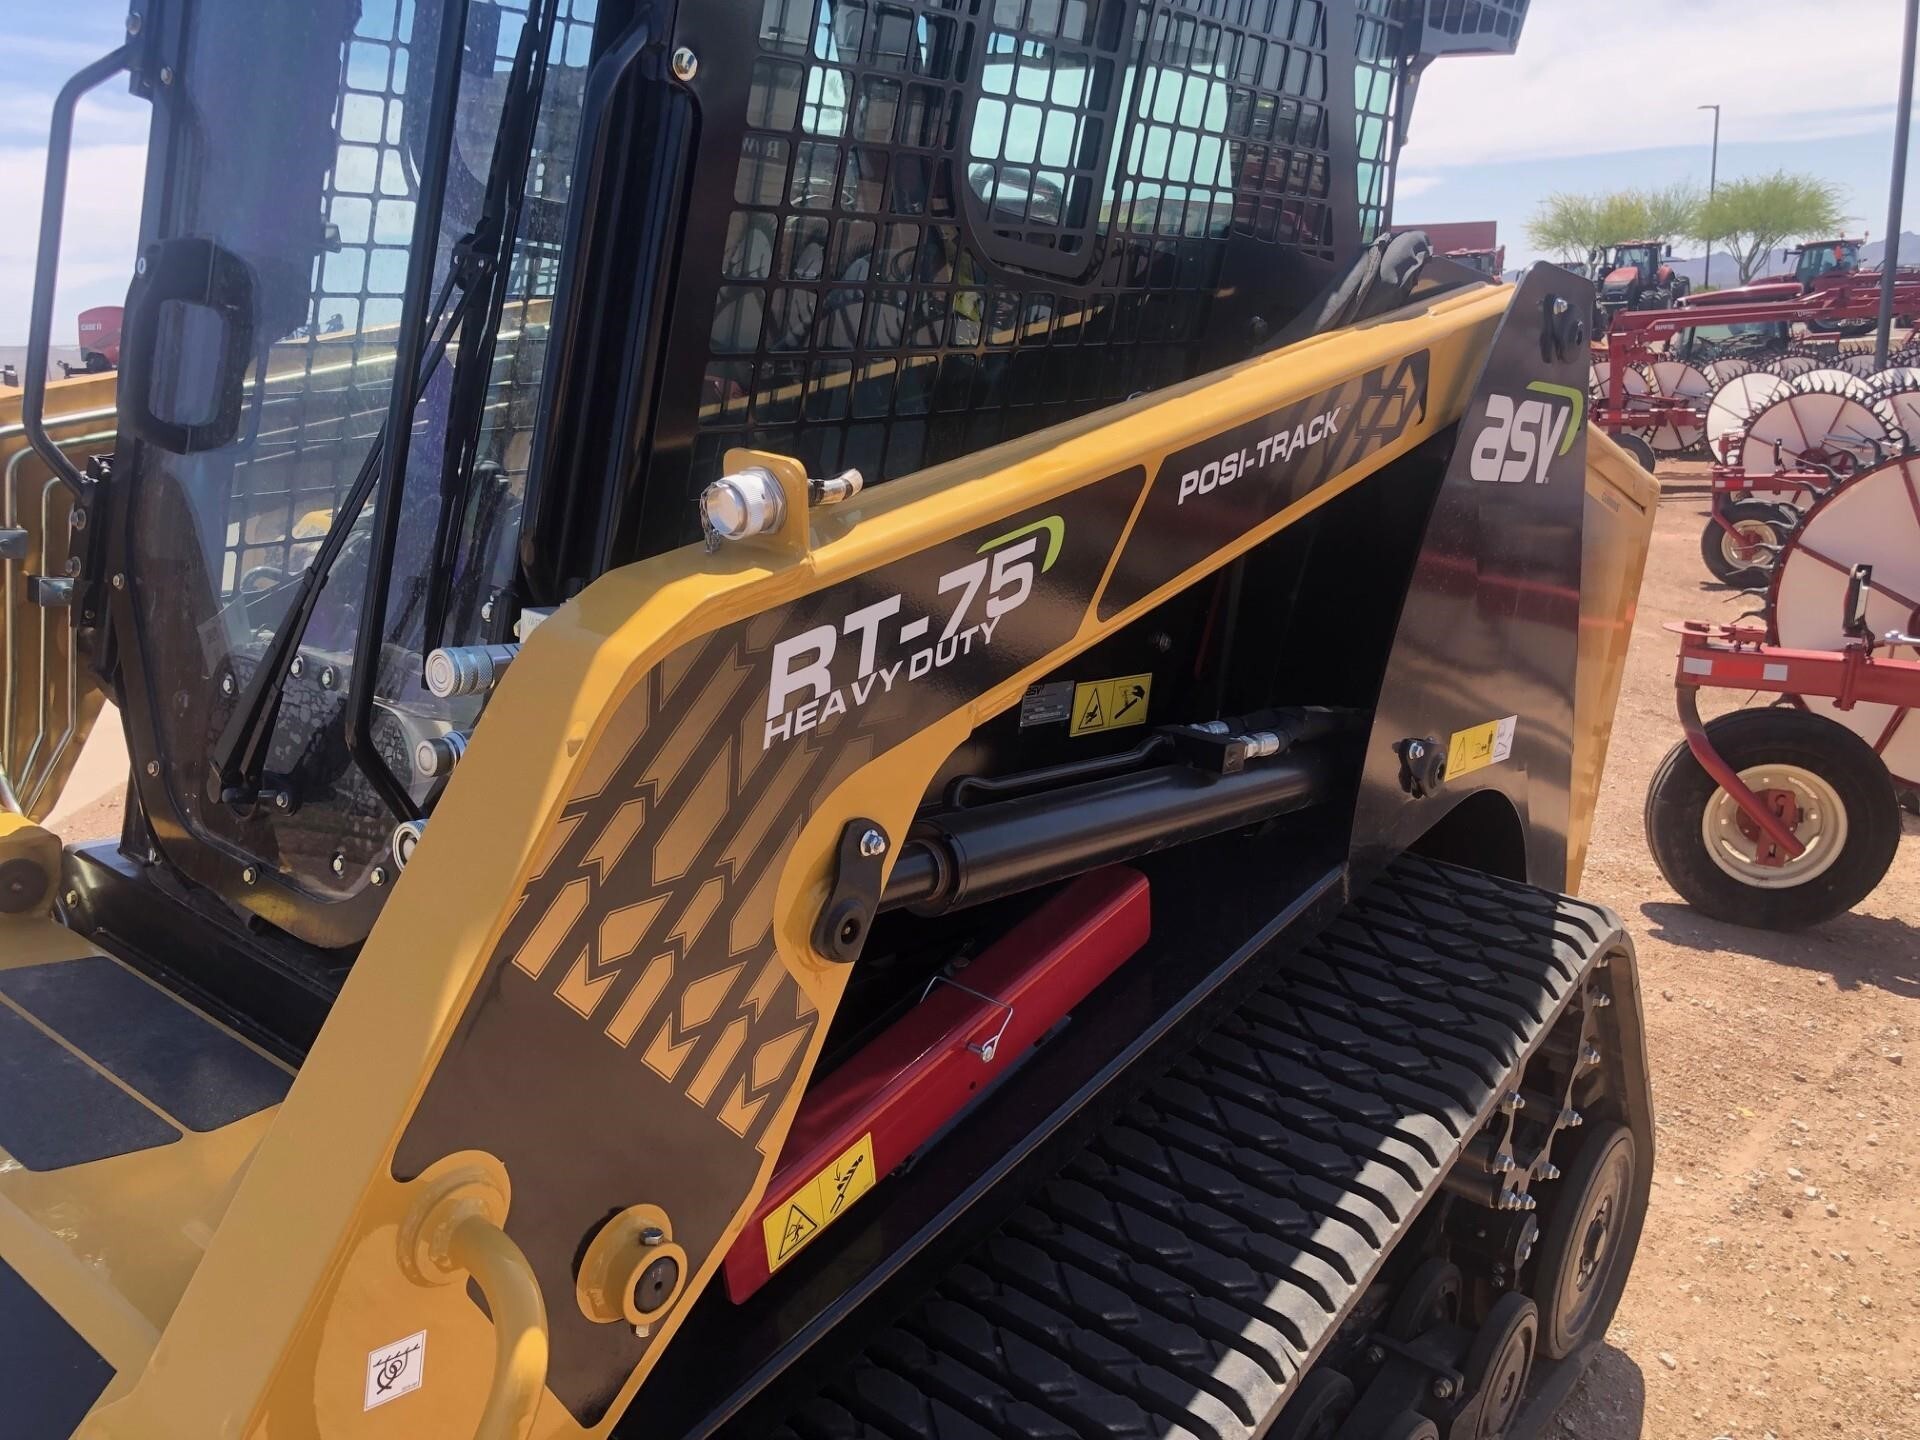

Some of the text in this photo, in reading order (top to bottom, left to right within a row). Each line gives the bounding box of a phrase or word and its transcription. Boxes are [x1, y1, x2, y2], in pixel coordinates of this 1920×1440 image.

[1177, 407, 1341, 505] POSI-TRACK
[762, 615, 1001, 751] HEAVY DUTY
[766, 537, 1037, 721] RT-75
